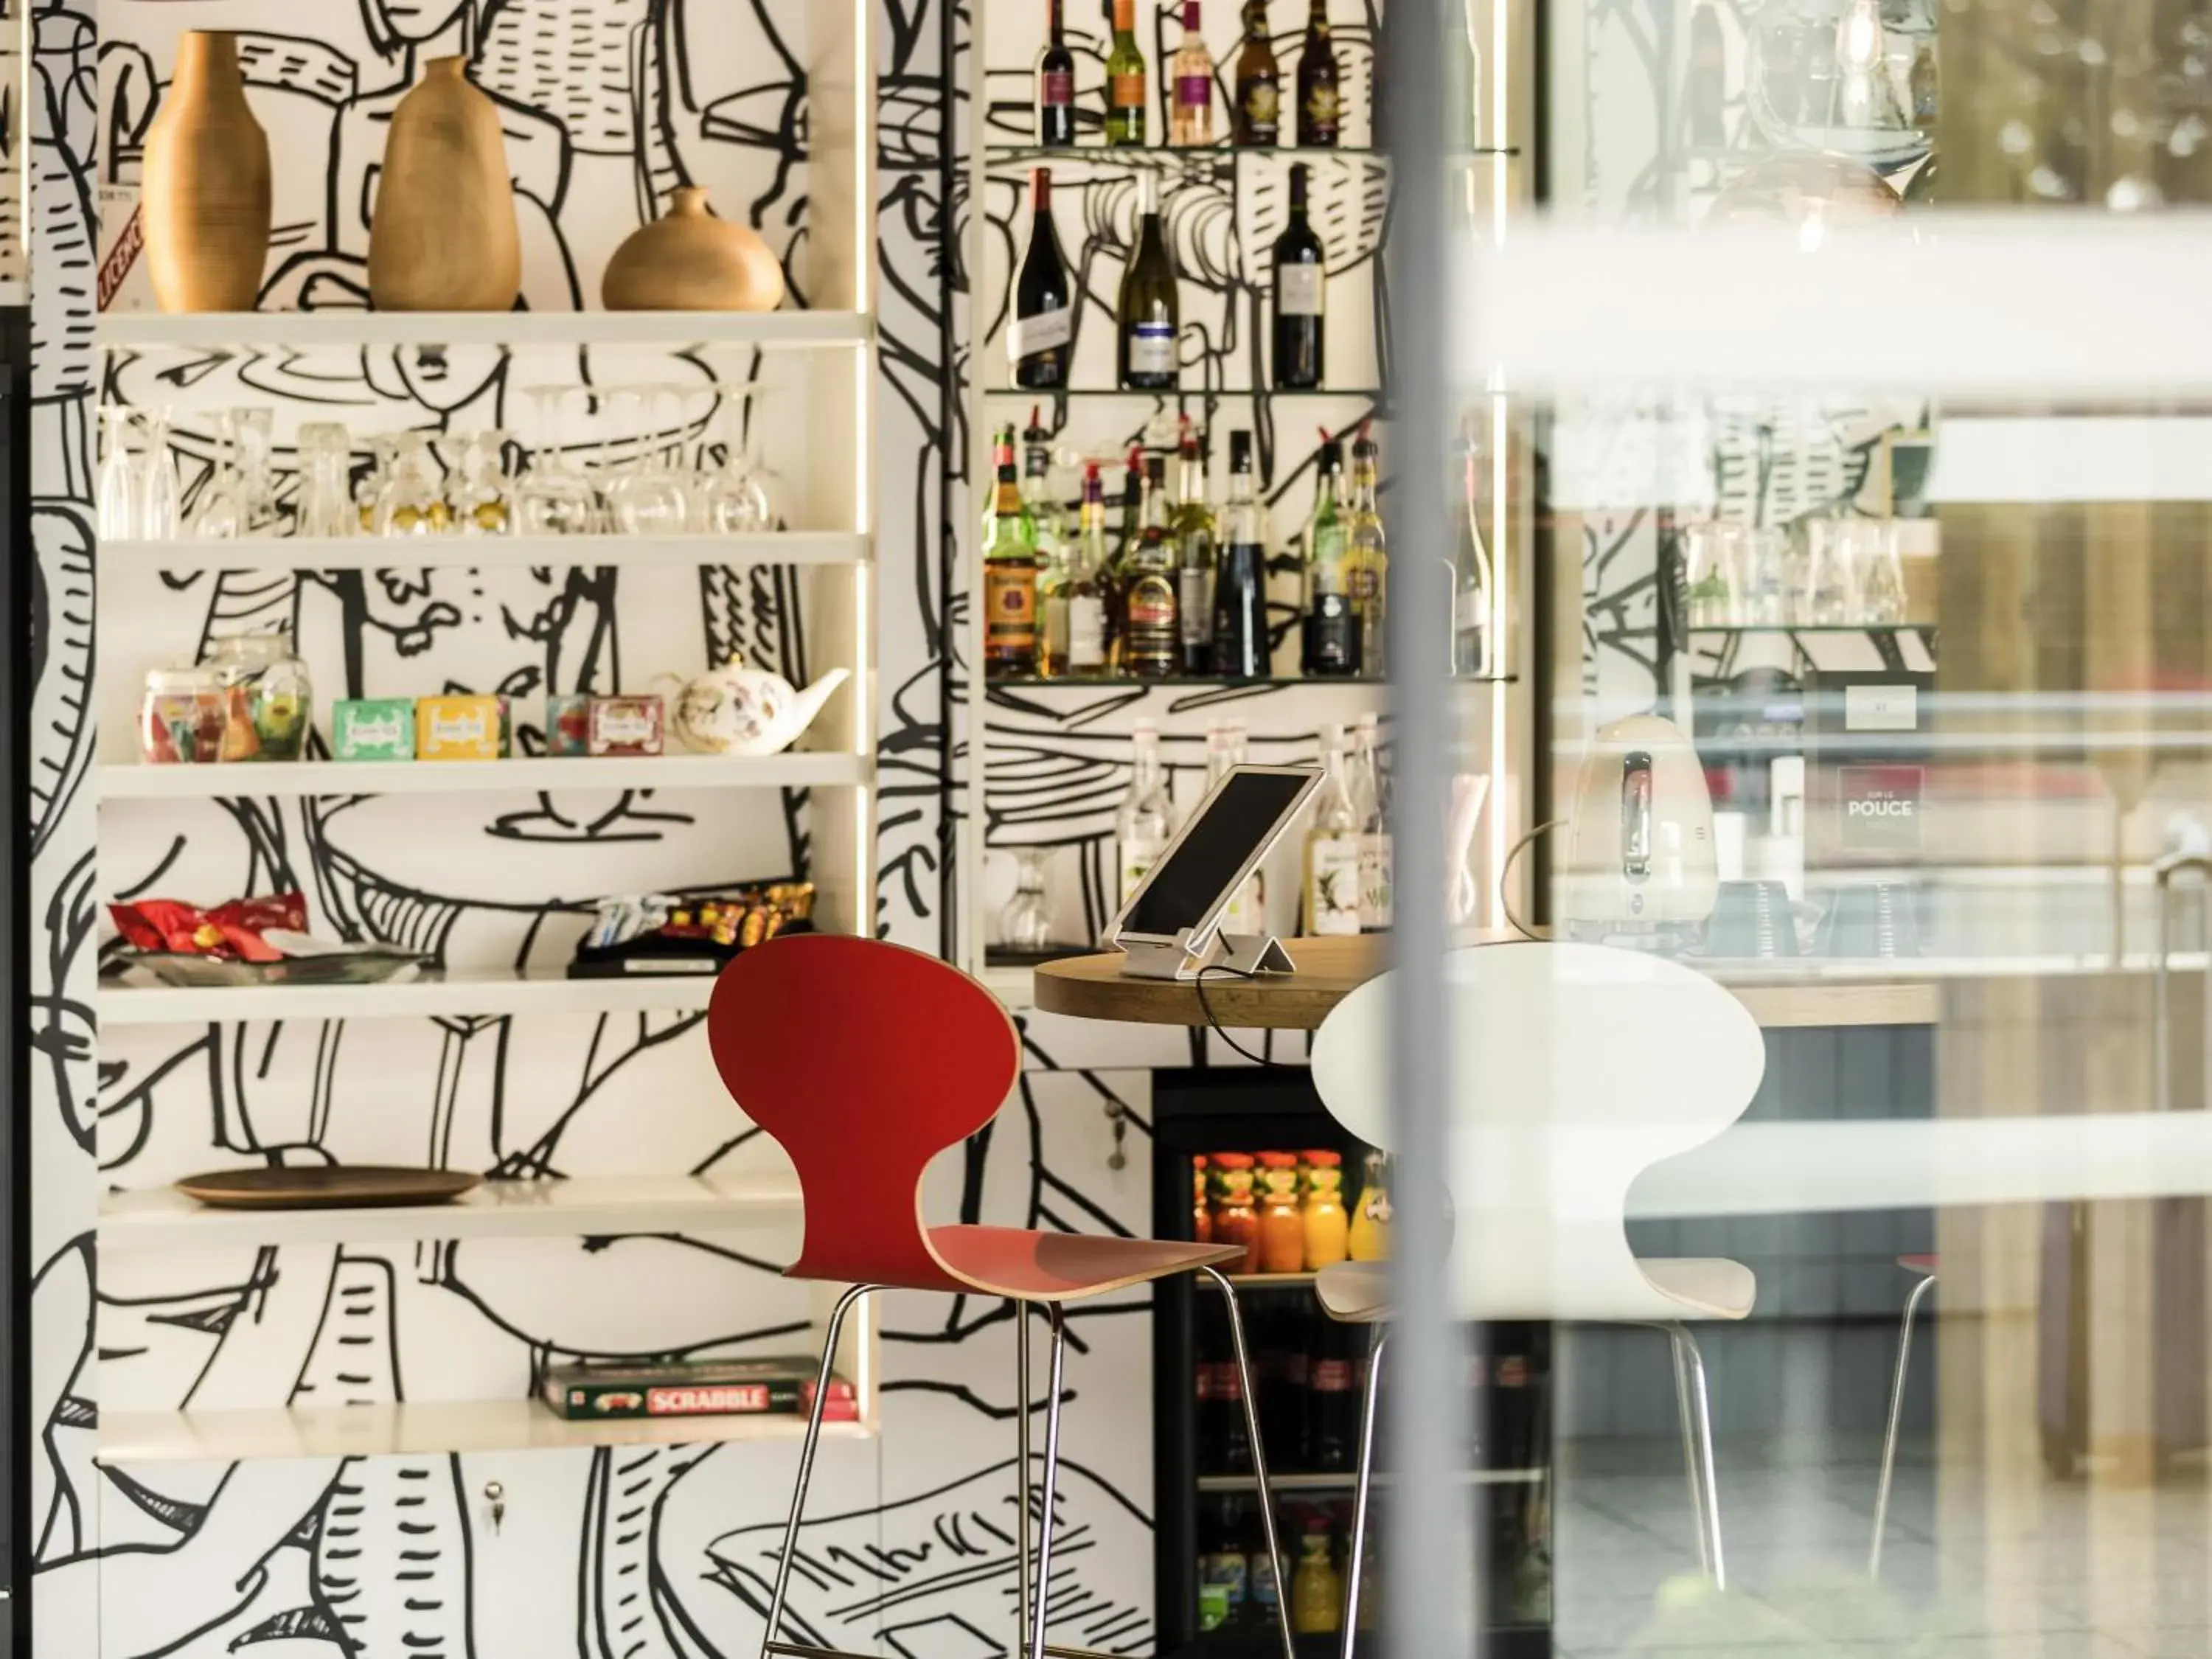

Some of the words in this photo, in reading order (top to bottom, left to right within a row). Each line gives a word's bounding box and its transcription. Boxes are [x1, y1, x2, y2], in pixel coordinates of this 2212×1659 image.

[98, 219, 142, 308] LICENC
[1848, 801, 1912, 816] POUCE
[652, 1388, 764, 1411] SCRABBLE
